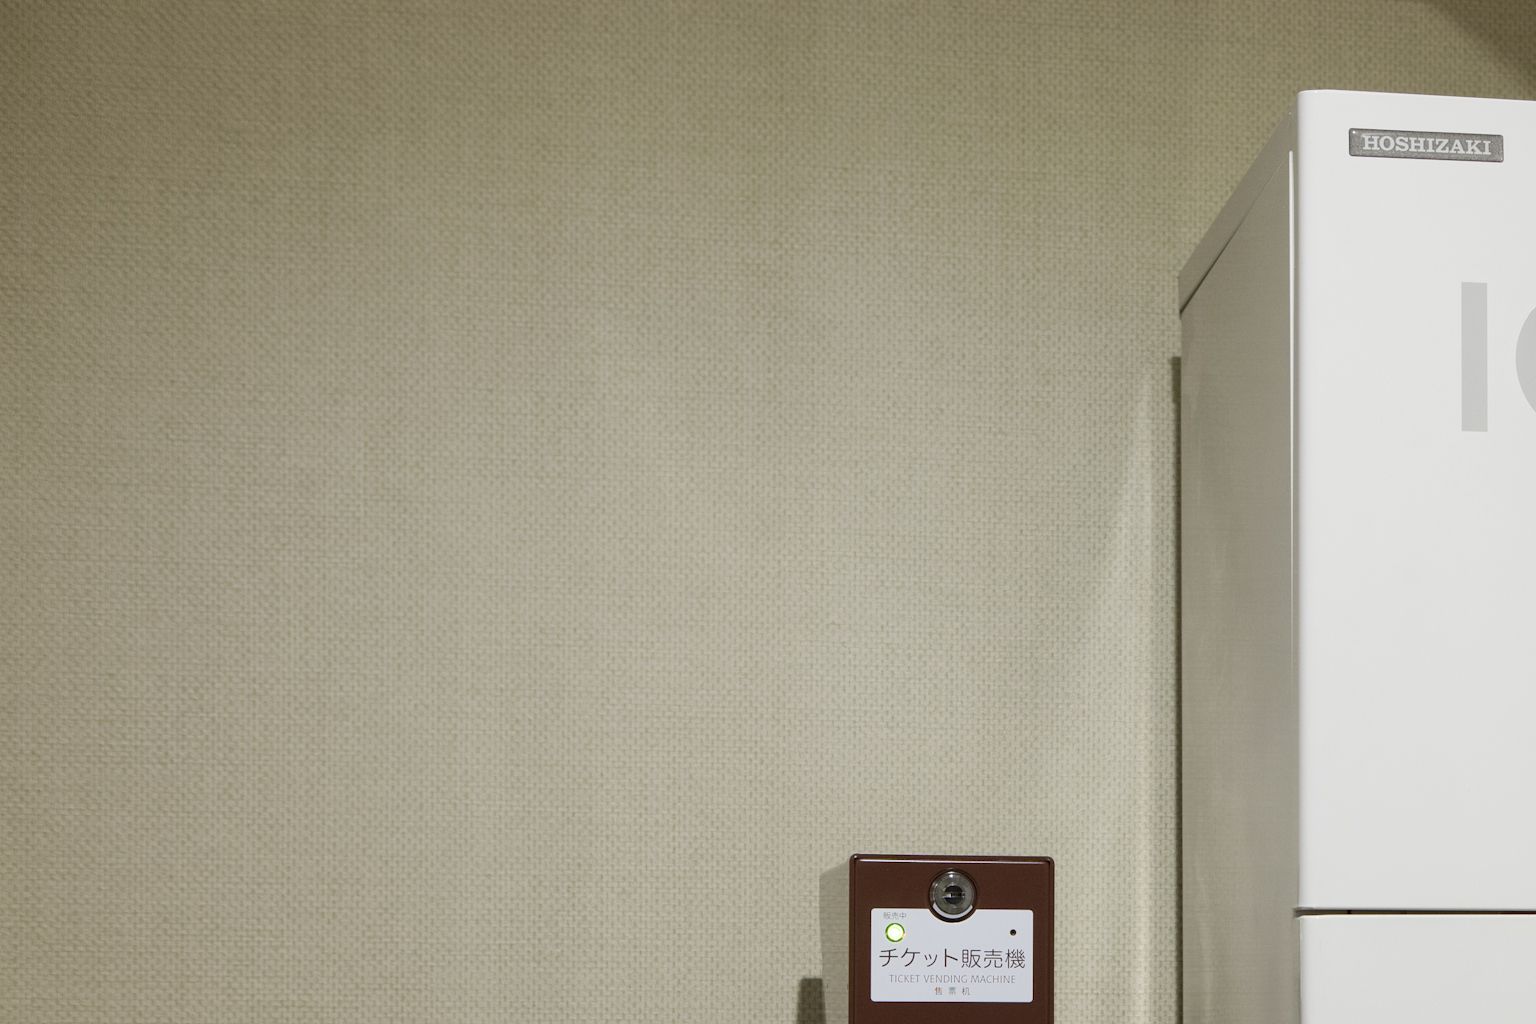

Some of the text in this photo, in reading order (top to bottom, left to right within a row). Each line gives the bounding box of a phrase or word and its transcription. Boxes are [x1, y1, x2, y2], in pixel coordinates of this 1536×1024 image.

[1362, 134, 1492, 155] HOSHIZAKI
[879, 947, 1026, 969] チケット販売機
[890, 974, 1016, 984] TICKET VENDING MACHINE
